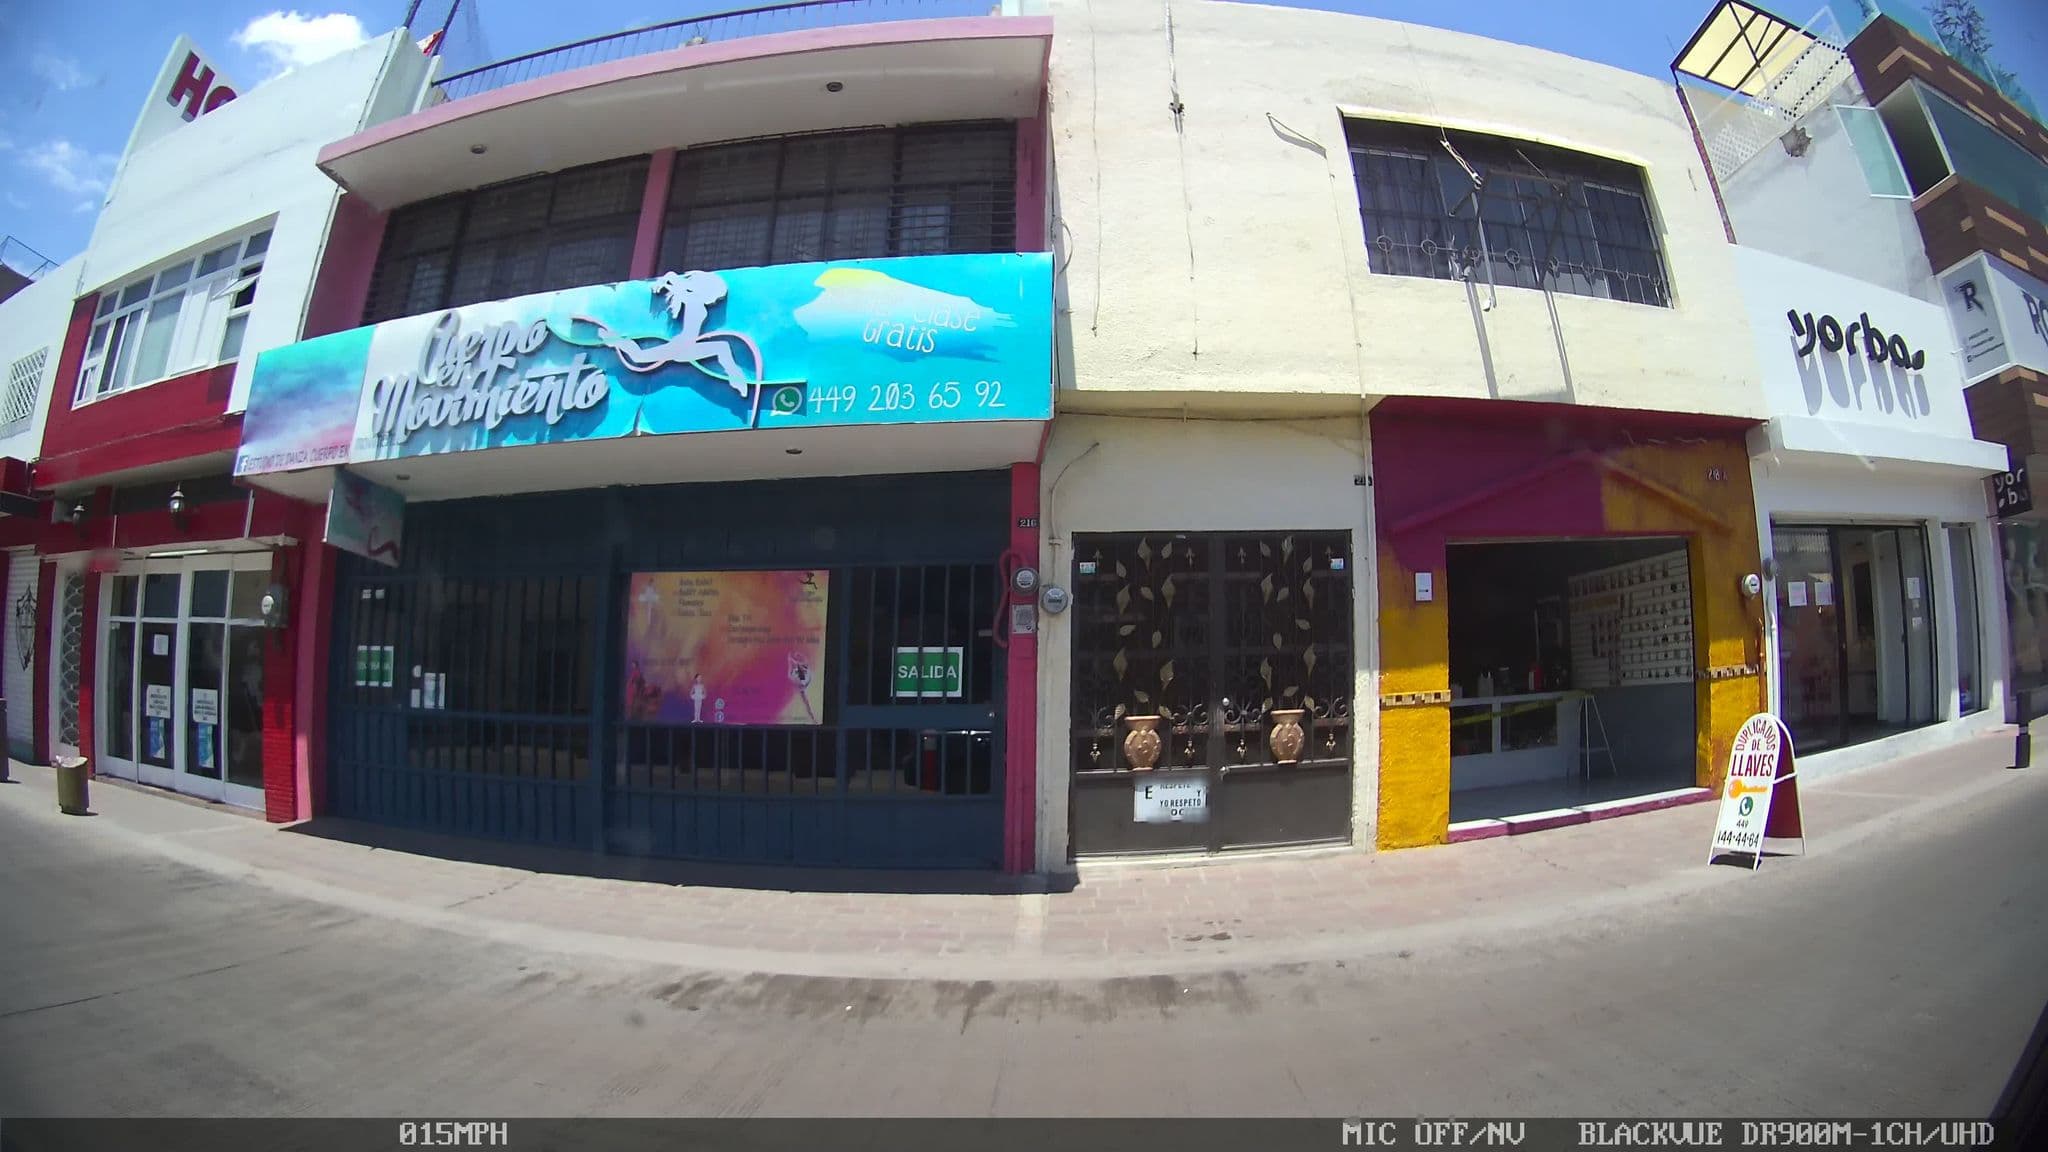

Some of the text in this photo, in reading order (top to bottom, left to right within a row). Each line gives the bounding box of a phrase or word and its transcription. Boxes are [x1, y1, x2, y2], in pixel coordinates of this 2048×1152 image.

[418, 309, 548, 394] Cuerpo
[372, 352, 609, 444] Movimiento
[808, 380, 1006, 413] 449 203 65 92
[1995, 468, 2024, 493] yor
[897, 665, 957, 678] SALIDA
[1735, 718, 1776, 751] DUPLICADOS
[1751, 738, 1761, 751] DE
[1731, 753, 1774, 777] LLAVES
[1160, 798, 1201, 808] YO RESPETO
[1736, 819, 1749, 828] 449
